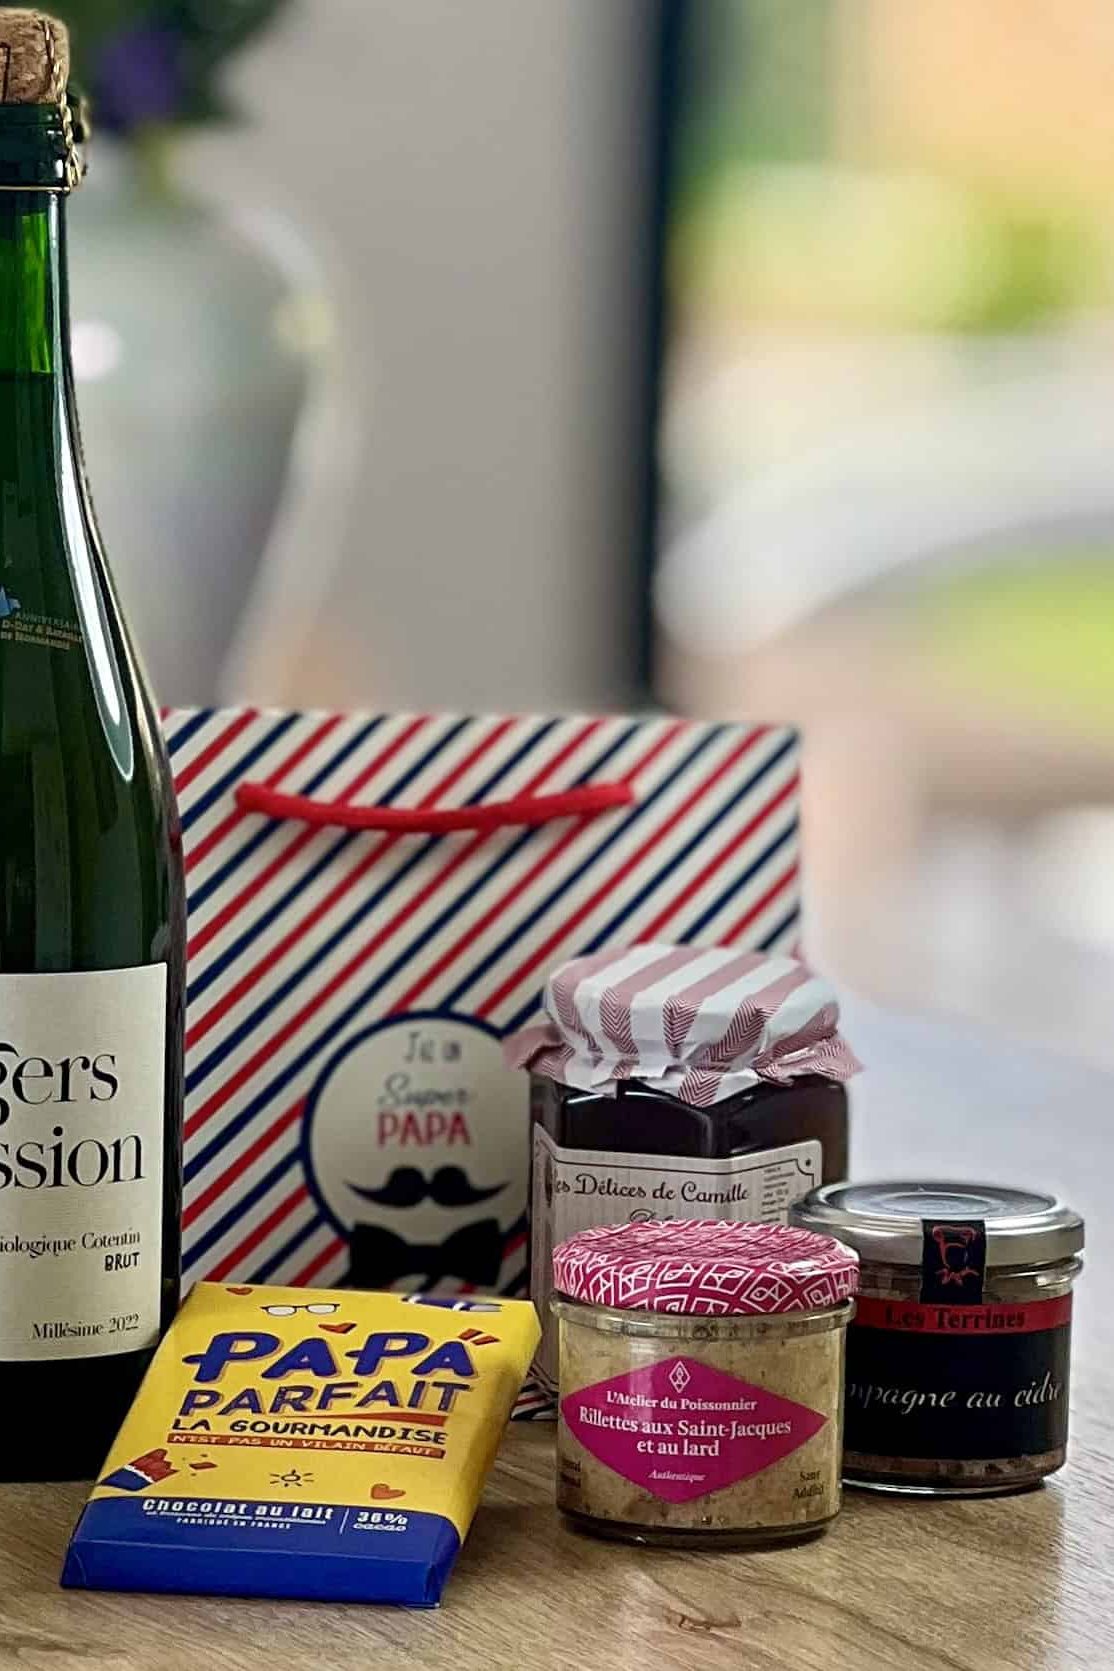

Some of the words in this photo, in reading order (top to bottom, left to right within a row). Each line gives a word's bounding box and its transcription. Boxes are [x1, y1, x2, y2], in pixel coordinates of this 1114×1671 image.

[377, 1111, 472, 1147] PAPA
[574, 1172, 648, 1200] Délices
[652, 1177, 676, 1201] de
[680, 1180, 751, 1205] Camille
[81, 1226, 141, 1250] Cotentin
[104, 1251, 140, 1272] BRUT
[31, 1320, 105, 1340] Millésime
[108, 1312, 140, 1334] 2022
[886, 1306, 926, 1328] Les
[935, 1308, 1026, 1330] Terrines
[181, 1331, 479, 1384] PAPA
[178, 1380, 472, 1418] PARFAIT
[660, 1396, 679, 1410] du
[680, 1397, 759, 1412] Poissonnier
[966, 1391, 1002, 1409] au
[171, 1418, 211, 1432] LA
[229, 1419, 449, 1446] GOURMANDISE
[578, 1405, 639, 1433] Rillettes
[641, 1419, 674, 1437] aux
[677, 1419, 792, 1441] Saint-Jacques
[227, 1435, 263, 1447] PAS
[269, 1438, 293, 1448] UN
[301, 1439, 367, 1451] VILAIN
[636, 1439, 655, 1455] et
[656, 1441, 680, 1456] au
[682, 1438, 721, 1458] lard
[141, 1498, 247, 1516] Chocolat
[254, 1504, 283, 1518] au
[290, 1505, 335, 1520] lait
[250, 1519, 291, 1530] FRANCE
